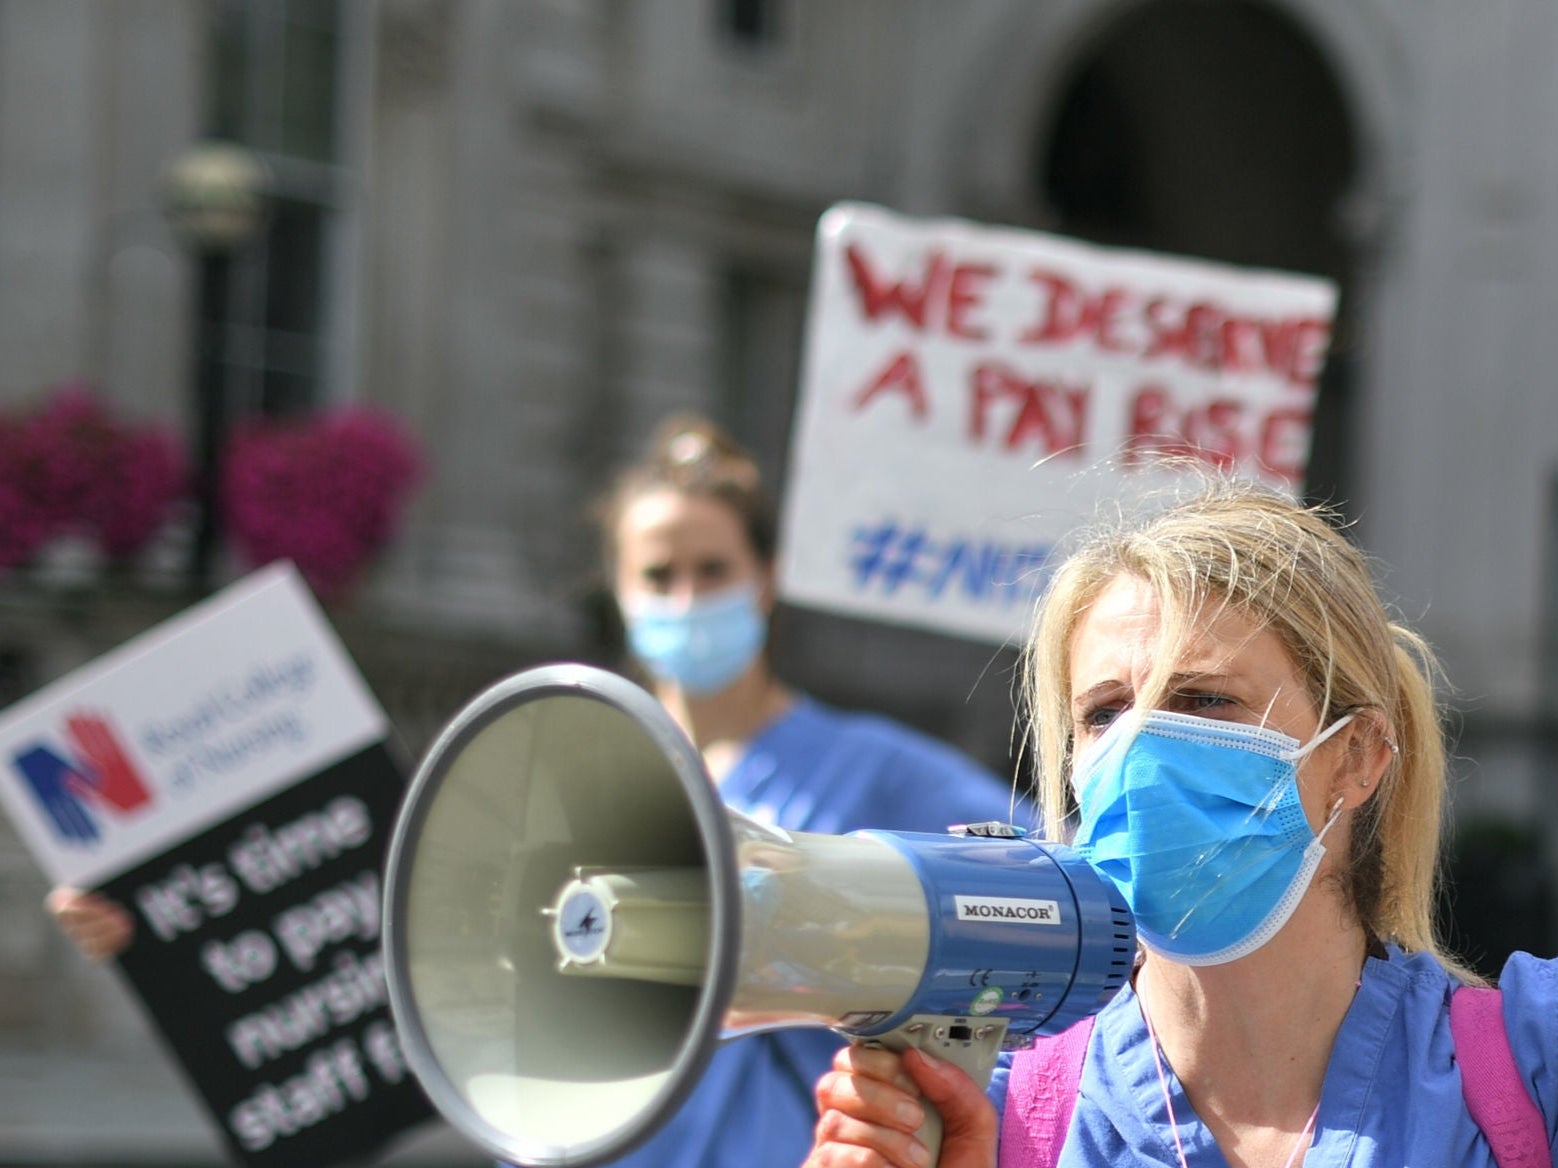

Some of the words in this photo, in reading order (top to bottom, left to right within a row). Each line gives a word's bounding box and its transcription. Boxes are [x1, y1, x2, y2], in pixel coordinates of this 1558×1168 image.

[846, 243, 999, 340] WE
[1018, 265, 1331, 388] DESERVE
[852, 350, 932, 425] A
[967, 361, 1090, 461] PAY
[138, 864, 239, 942] It's
[229, 797, 371, 893] time
[203, 930, 278, 992] to
[275, 871, 381, 971] pay
[231, 1040, 368, 1150] staff
